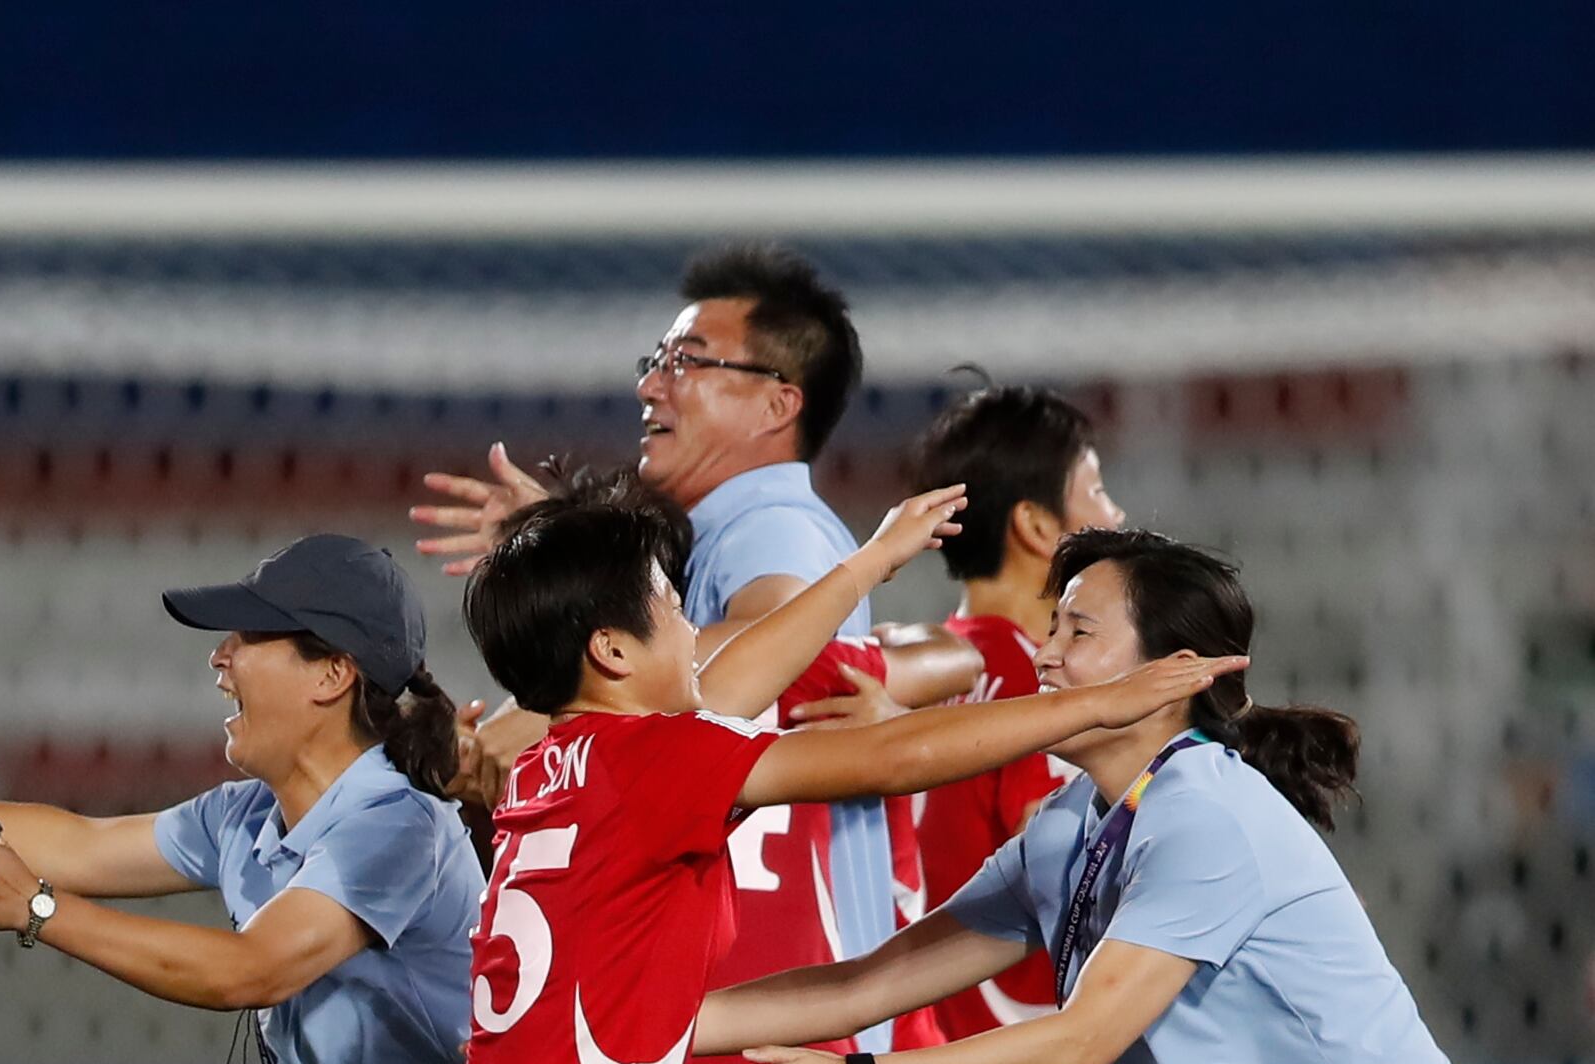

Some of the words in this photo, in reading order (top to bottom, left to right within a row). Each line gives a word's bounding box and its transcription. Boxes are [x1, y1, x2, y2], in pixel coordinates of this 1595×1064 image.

[537, 732, 596, 799] SON
[1062, 924, 1076, 962] WORLD
[1070, 902, 1084, 925] CUP
